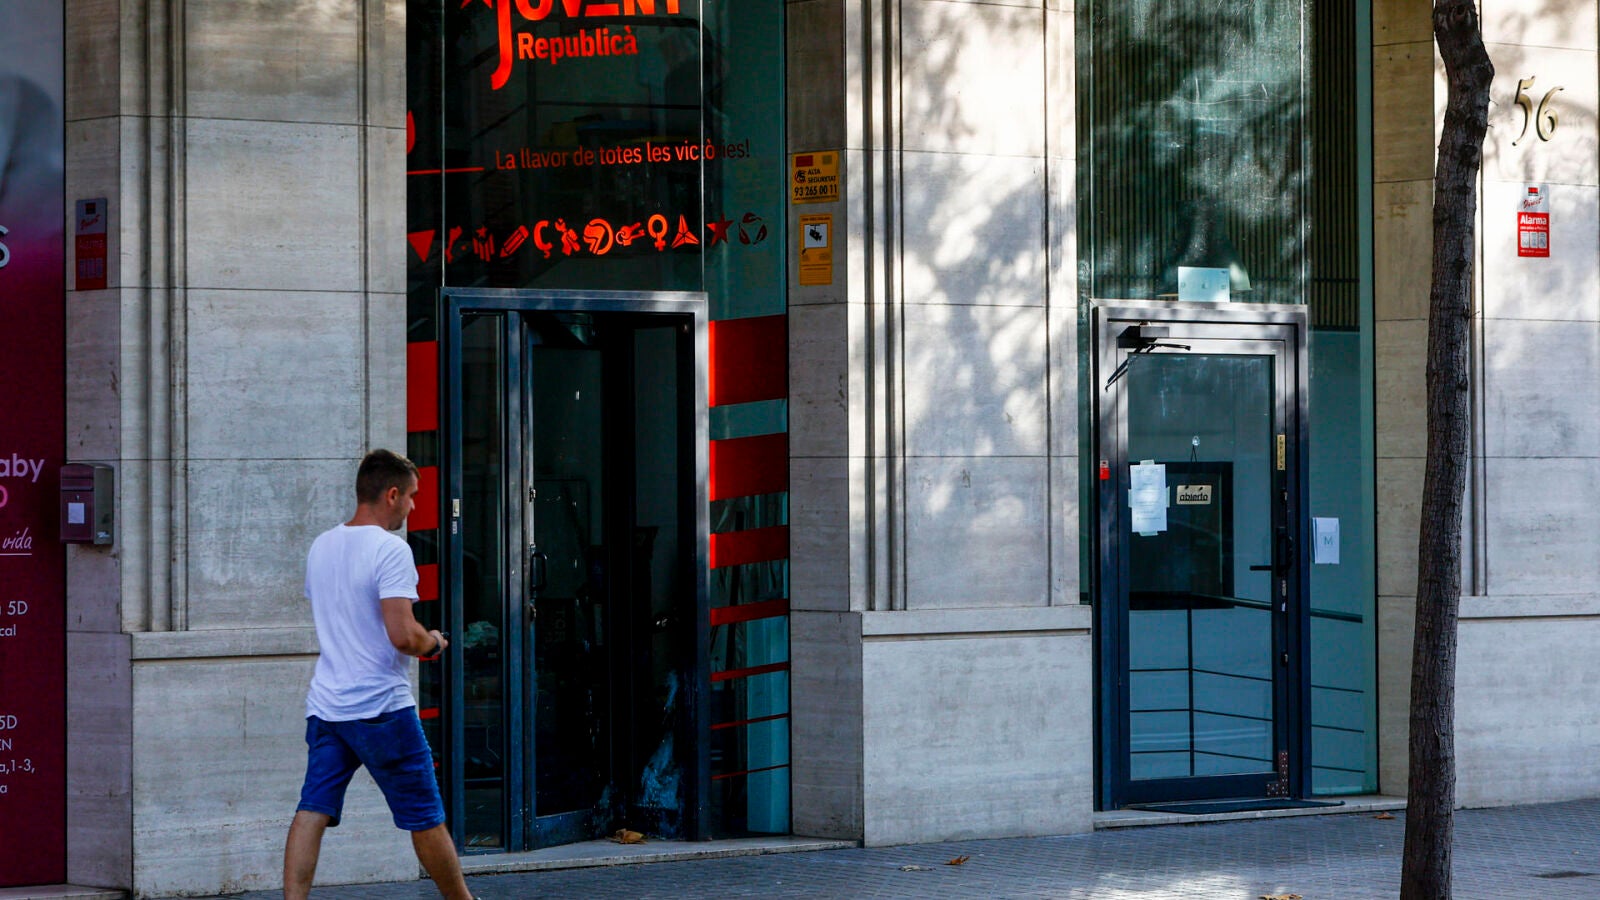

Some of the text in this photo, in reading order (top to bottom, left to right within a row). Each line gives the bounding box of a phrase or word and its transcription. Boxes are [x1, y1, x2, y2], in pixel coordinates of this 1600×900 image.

[517, 25, 638, 65] Republicà
[1512, 75, 1564, 146] 56
[495, 150, 516, 170] La
[521, 148, 569, 169] llavor
[573, 145, 594, 166] de
[600, 146, 642, 165] totes
[647, 141, 670, 162] les
[795, 183, 838, 196] 93 265 00 11
[1520, 214, 1547, 225] Alarma
[1179, 492, 1209, 502] abierto
[2, 527, 33, 550] vida
[7, 600, 28, 616] 5D
